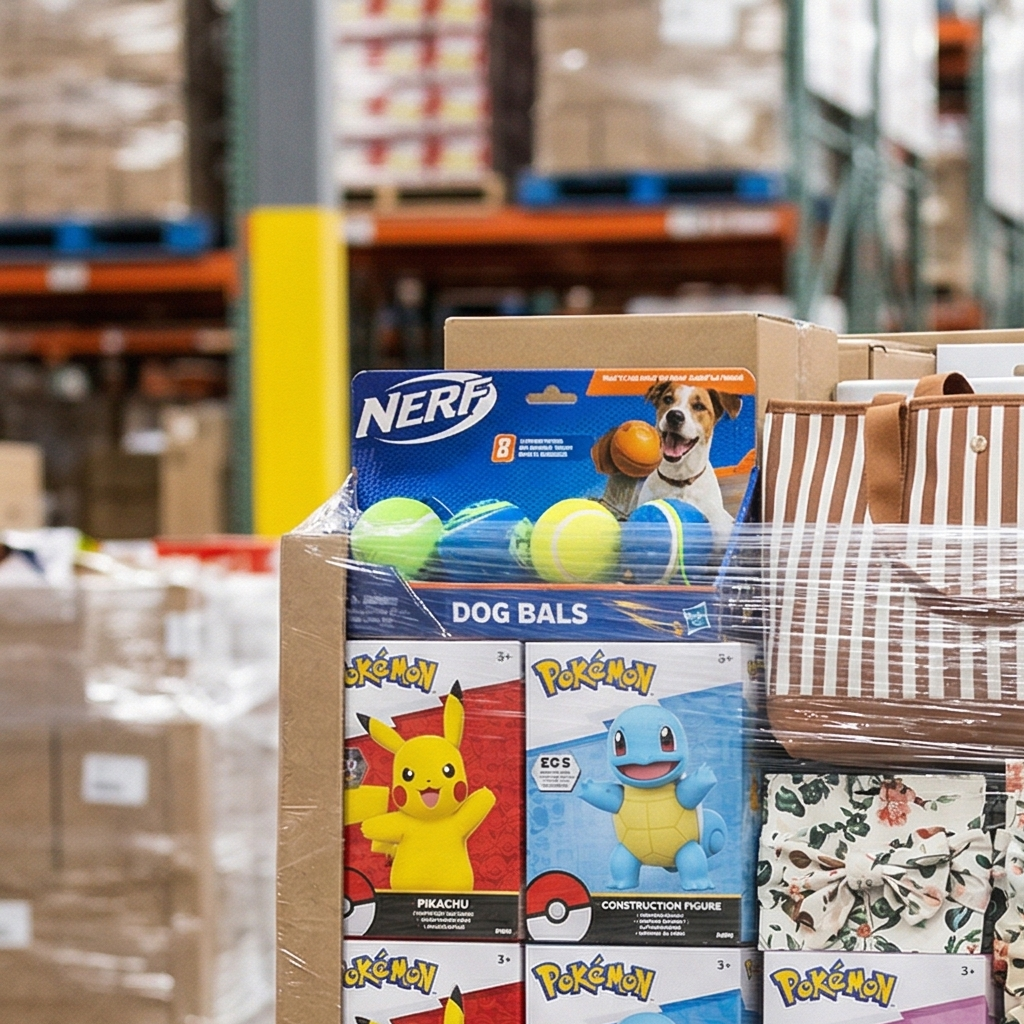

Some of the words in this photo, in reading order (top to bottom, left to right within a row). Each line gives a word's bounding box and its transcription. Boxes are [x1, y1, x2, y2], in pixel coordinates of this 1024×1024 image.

[355, 375, 494, 439] NERF
[496, 437, 512, 459] 8
[452, 601, 510, 623] DOG
[518, 602, 588, 625] BALS
[344, 646, 439, 695] okémon
[417, 898, 470, 909] PIKACHU
[601, 900, 682, 911] CONSTRUCTION
[684, 901, 722, 912] FIGURE
[343, 947, 439, 996] okémon
